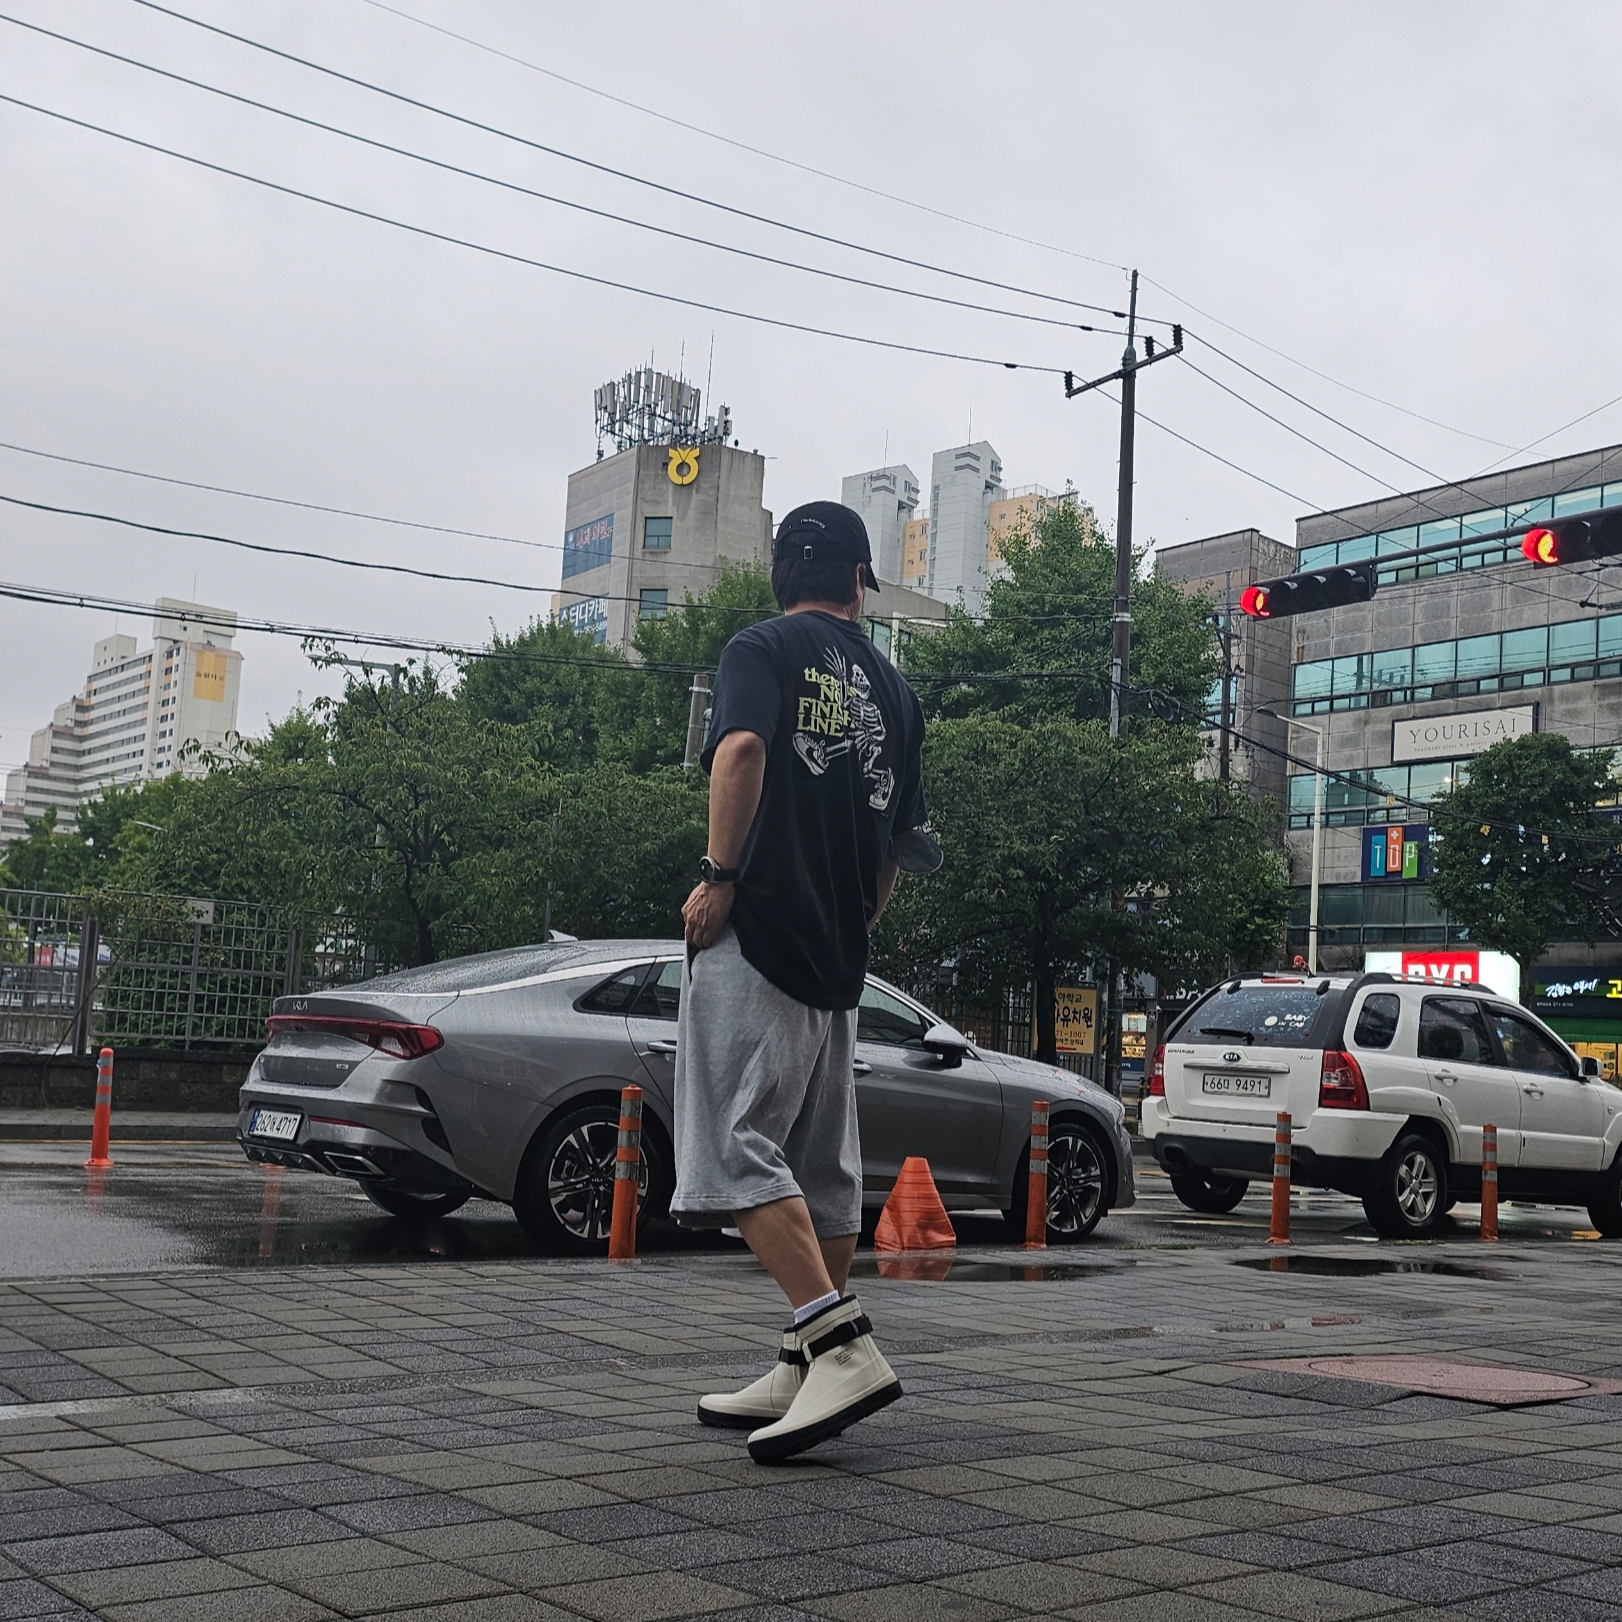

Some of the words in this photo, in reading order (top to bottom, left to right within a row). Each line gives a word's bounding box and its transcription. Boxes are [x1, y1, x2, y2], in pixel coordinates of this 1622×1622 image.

[803, 666, 840, 691] there
[797, 714, 844, 738] LINE
[1409, 718, 1516, 744] YOURISAI
[1374, 843, 1415, 869] TOP
[1285, 1013, 1310, 1022] BABY
[1225, 1053, 1238, 1061] KIA
[1235, 1078, 1262, 1093] 9491
[276, 1116, 298, 1135] 4717
